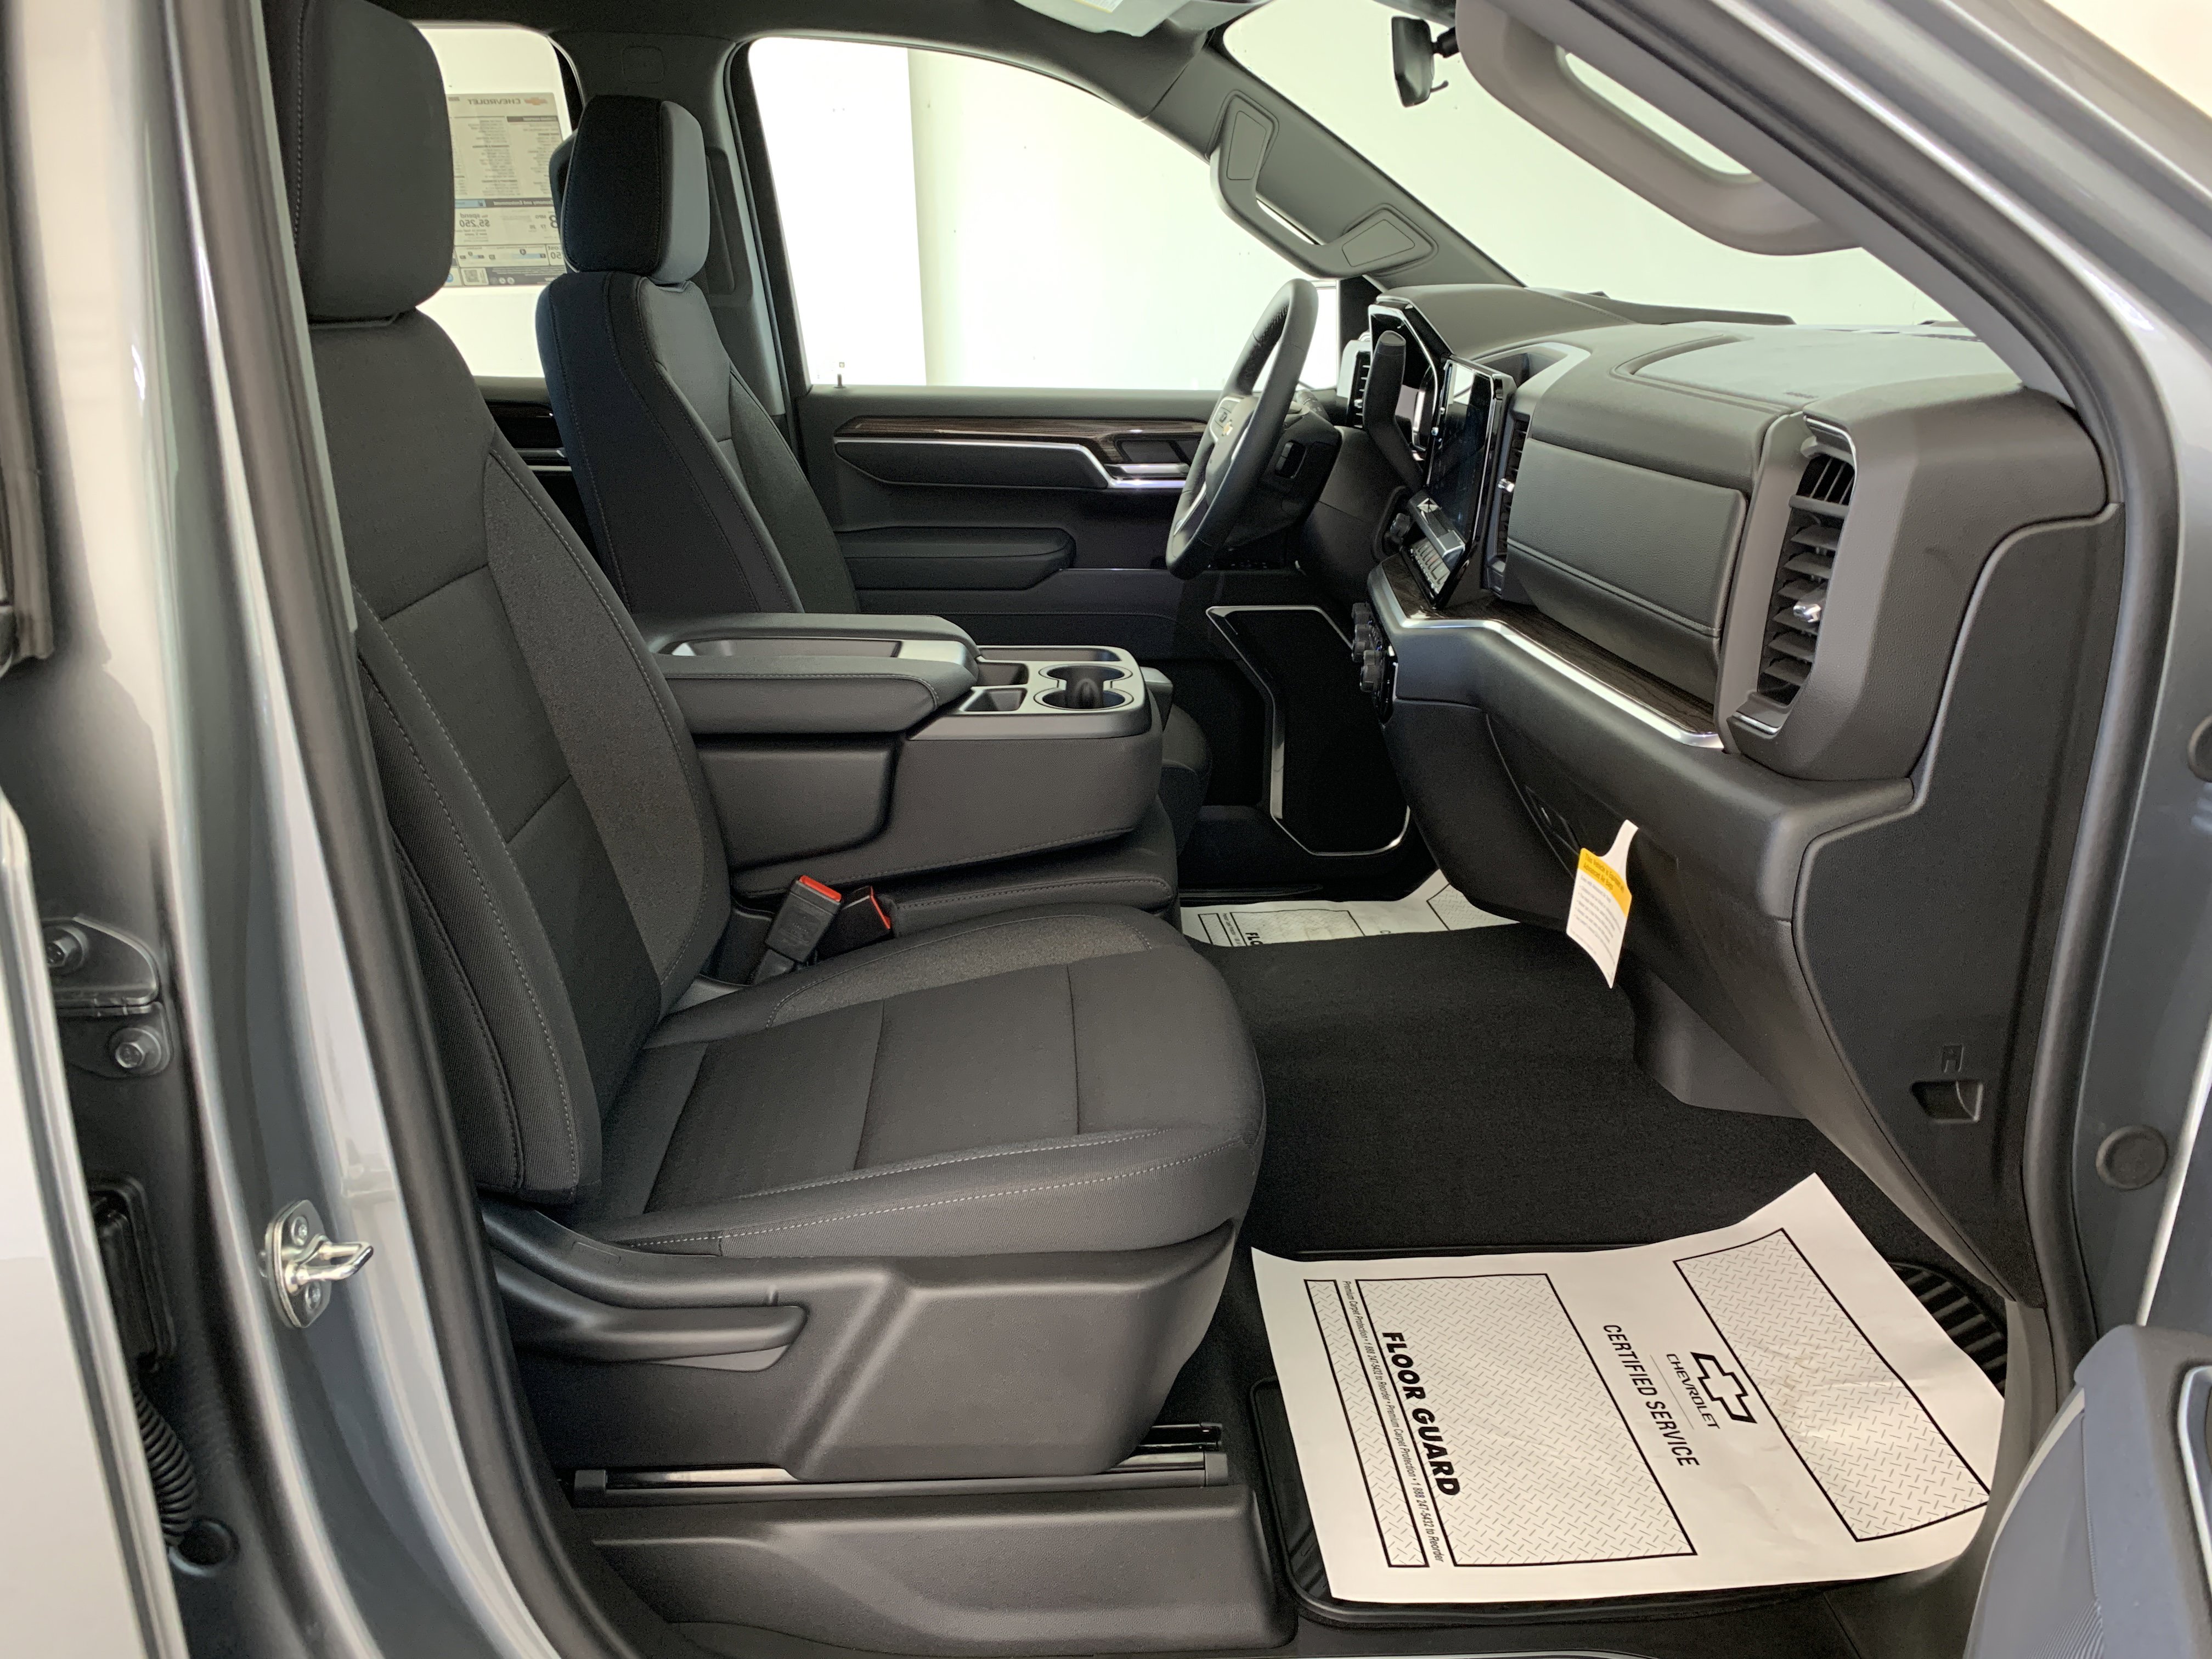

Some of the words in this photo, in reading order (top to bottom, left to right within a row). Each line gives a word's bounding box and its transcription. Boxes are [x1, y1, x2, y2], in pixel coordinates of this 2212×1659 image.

[1342, 1280, 1355, 1300] Premium
[1349, 1301, 1361, 1316] Carpet
[1356, 1316, 1368, 1339] Protection
[1377, 1381, 1391, 1400] Reorder
[1603, 1325, 1658, 1396] CERTIFIED
[1646, 1401, 1700, 1466] SERVICE
[1666, 1354, 1720, 1429] CHEVROLET
[1382, 1333, 1426, 1399] FLOOR
[1412, 1408, 1460, 1496] GUARD
[1386, 1404, 1400, 1427] Premium
[1393, 1429, 1408, 1448] Carpet
[1400, 1448, 1417, 1477] Protection
[1413, 1487, 1425, 1499] 888
[1417, 1499, 1435, 1530] 247-5432
[1428, 1536, 1444, 1562] Reorder
